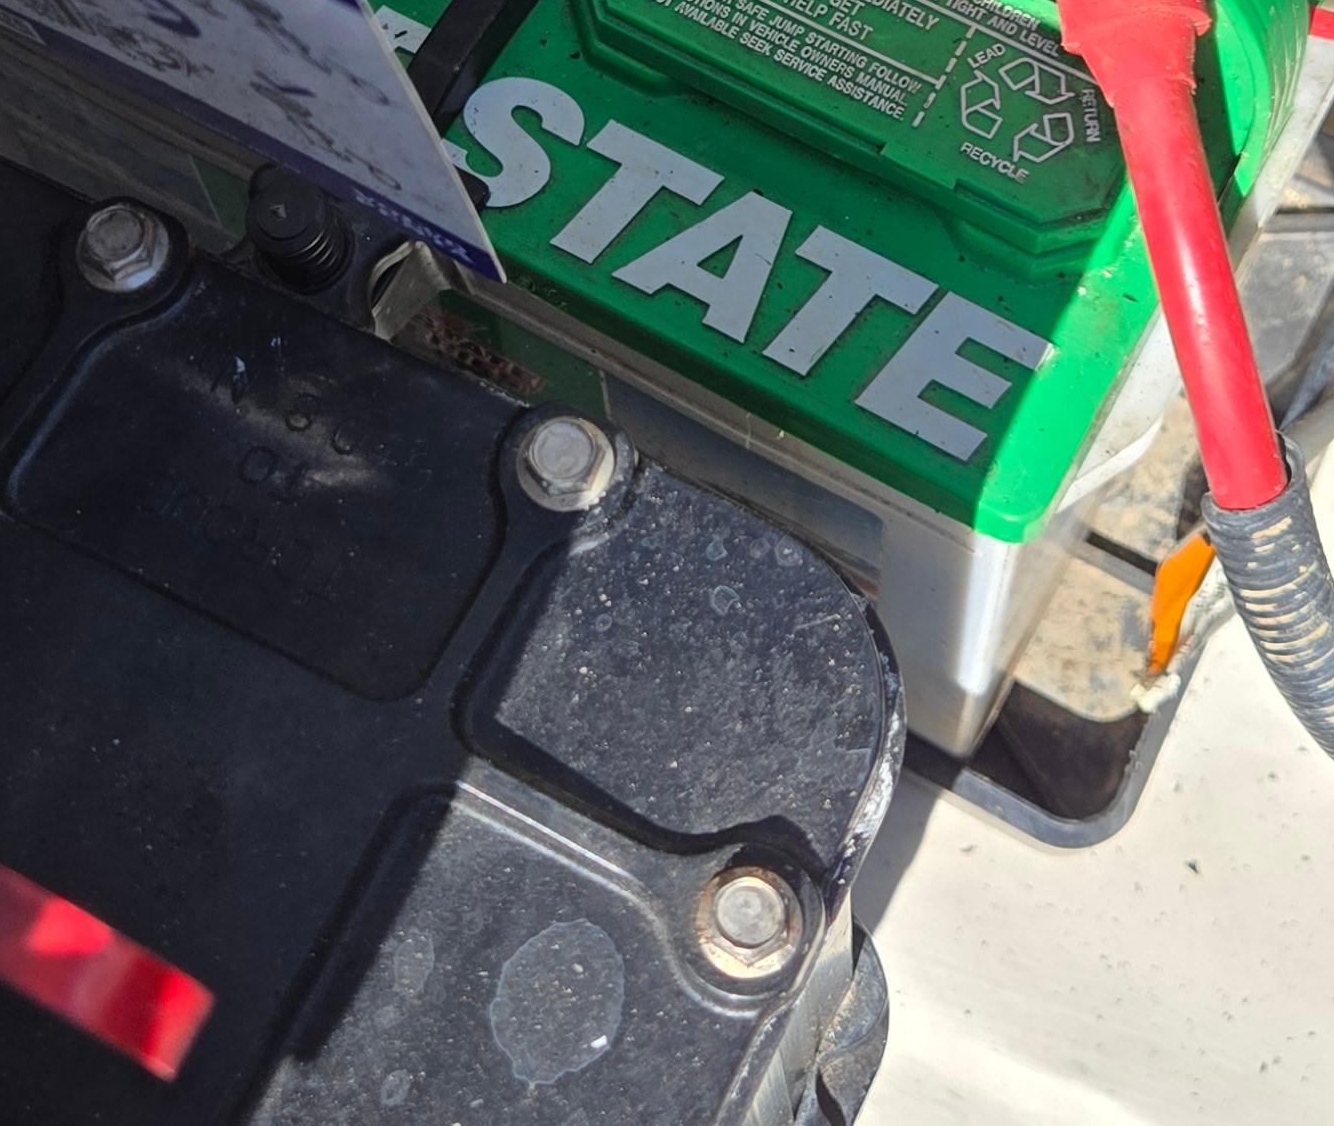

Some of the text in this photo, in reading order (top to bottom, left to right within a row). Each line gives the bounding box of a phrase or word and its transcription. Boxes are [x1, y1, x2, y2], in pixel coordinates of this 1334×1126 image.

[732, 12, 748, 28] IN
[750, 20, 800, 52] VEHICLE
[801, 46, 855, 80] OWNERS
[829, 12, 873, 40] FAST
[987, 16, 1017, 34] AND
[1019, 29, 1058, 57] LEVEL
[675, 2, 740, 38] AVAILABLE
[740, 32, 772, 55] SEEK
[774, 49, 827, 81] SERVICE
[827, 75, 904, 120] ASSISTANCE.
[769, 15, 804, 36] JUMP
[805, 32, 867, 68] STARTING
[868, 62, 921, 93] FOLLOW
[968, 43, 1006, 68] LEAD
[1080, 89, 1101, 142] RETURN
[960, 142, 1029, 184] RECYCLE
[370, 5, 1053, 462] STATE
